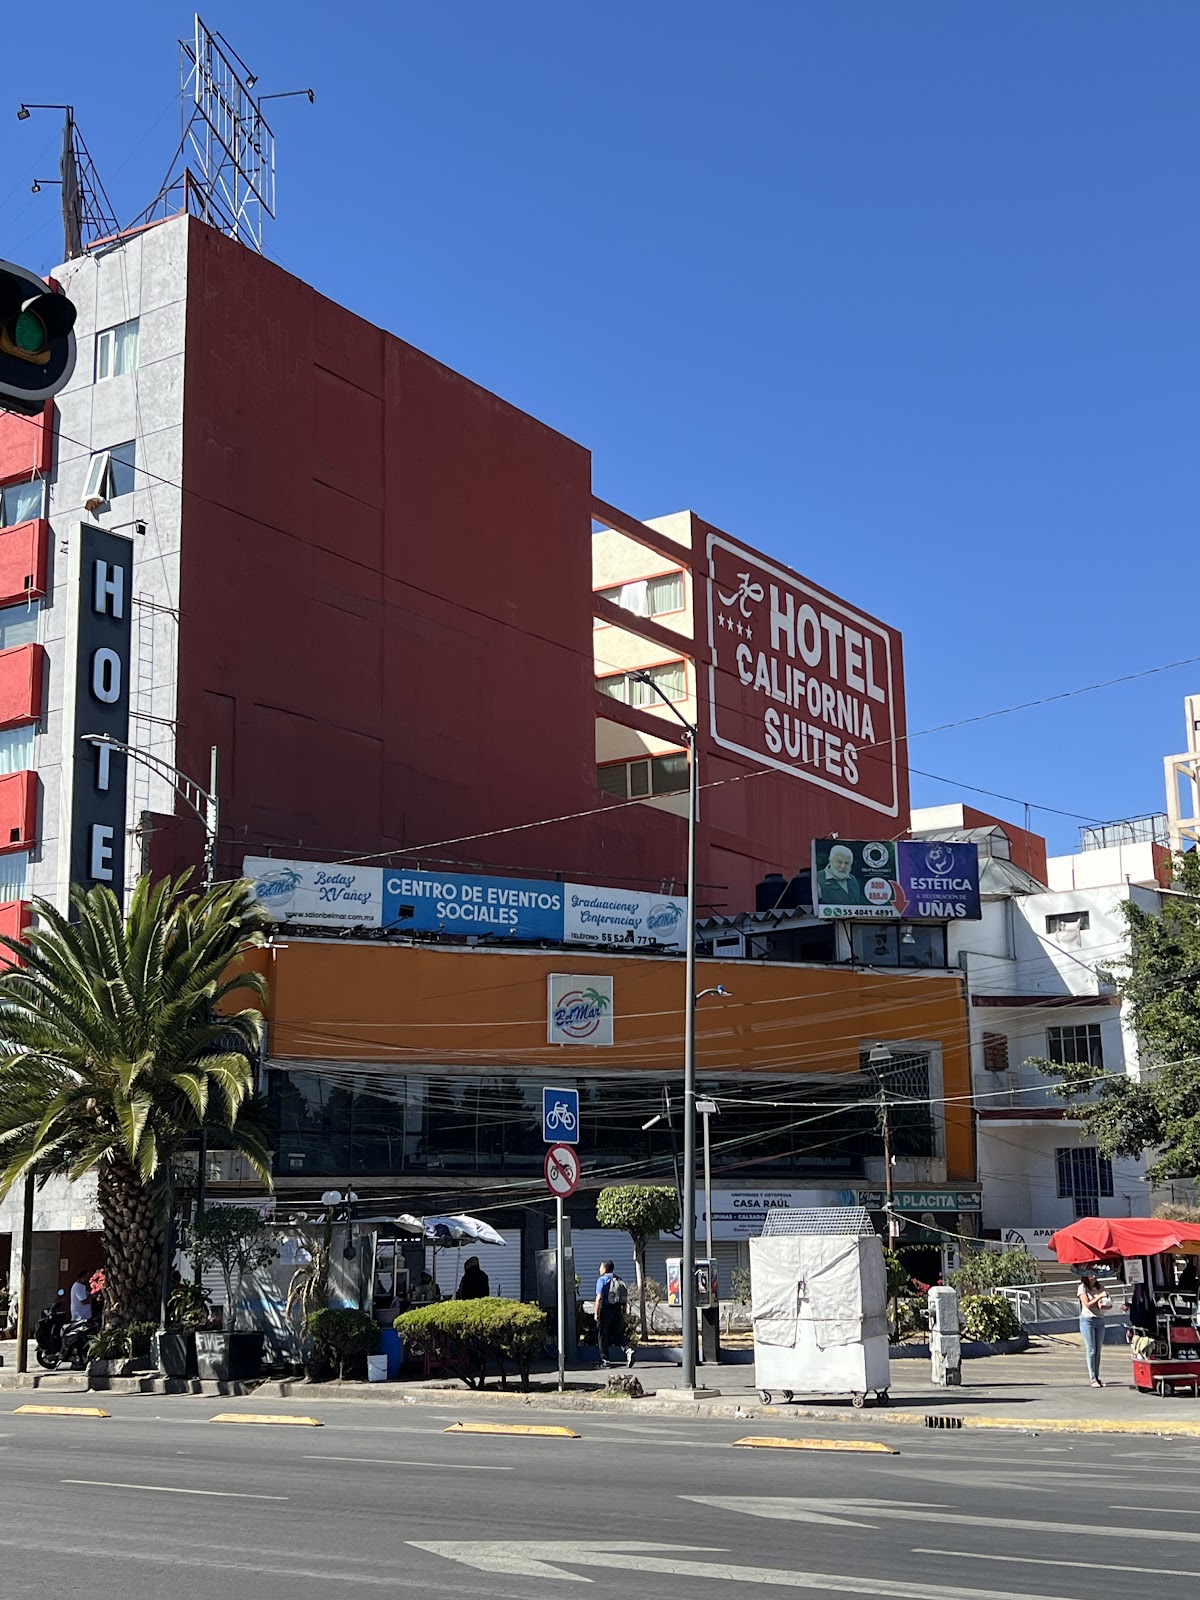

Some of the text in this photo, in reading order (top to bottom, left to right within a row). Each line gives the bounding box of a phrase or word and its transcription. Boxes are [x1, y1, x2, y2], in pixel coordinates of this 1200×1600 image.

[770, 583, 885, 704] HOTEL
[736, 643, 875, 744] CALIFORNIA
[91, 558, 123, 881] HOTE
[764, 707, 860, 785] SUITES
[314, 871, 356, 888] Bodas
[910, 874, 973, 891] ESTÉTICA
[319, 887, 372, 905] XV años
[387, 878, 561, 911] CENTRO DE EVENTOS
[436, 902, 519, 925] SOCIALES
[571, 894, 639, 915] Graduaciones
[918, 899, 967, 918] UÑAS
[580, 910, 642, 929] Conferencias
[601, 933, 613, 942] 55
[733, 1197, 790, 1208] CASA RAÚL
[903, 1195, 955, 1208] PLACITA
